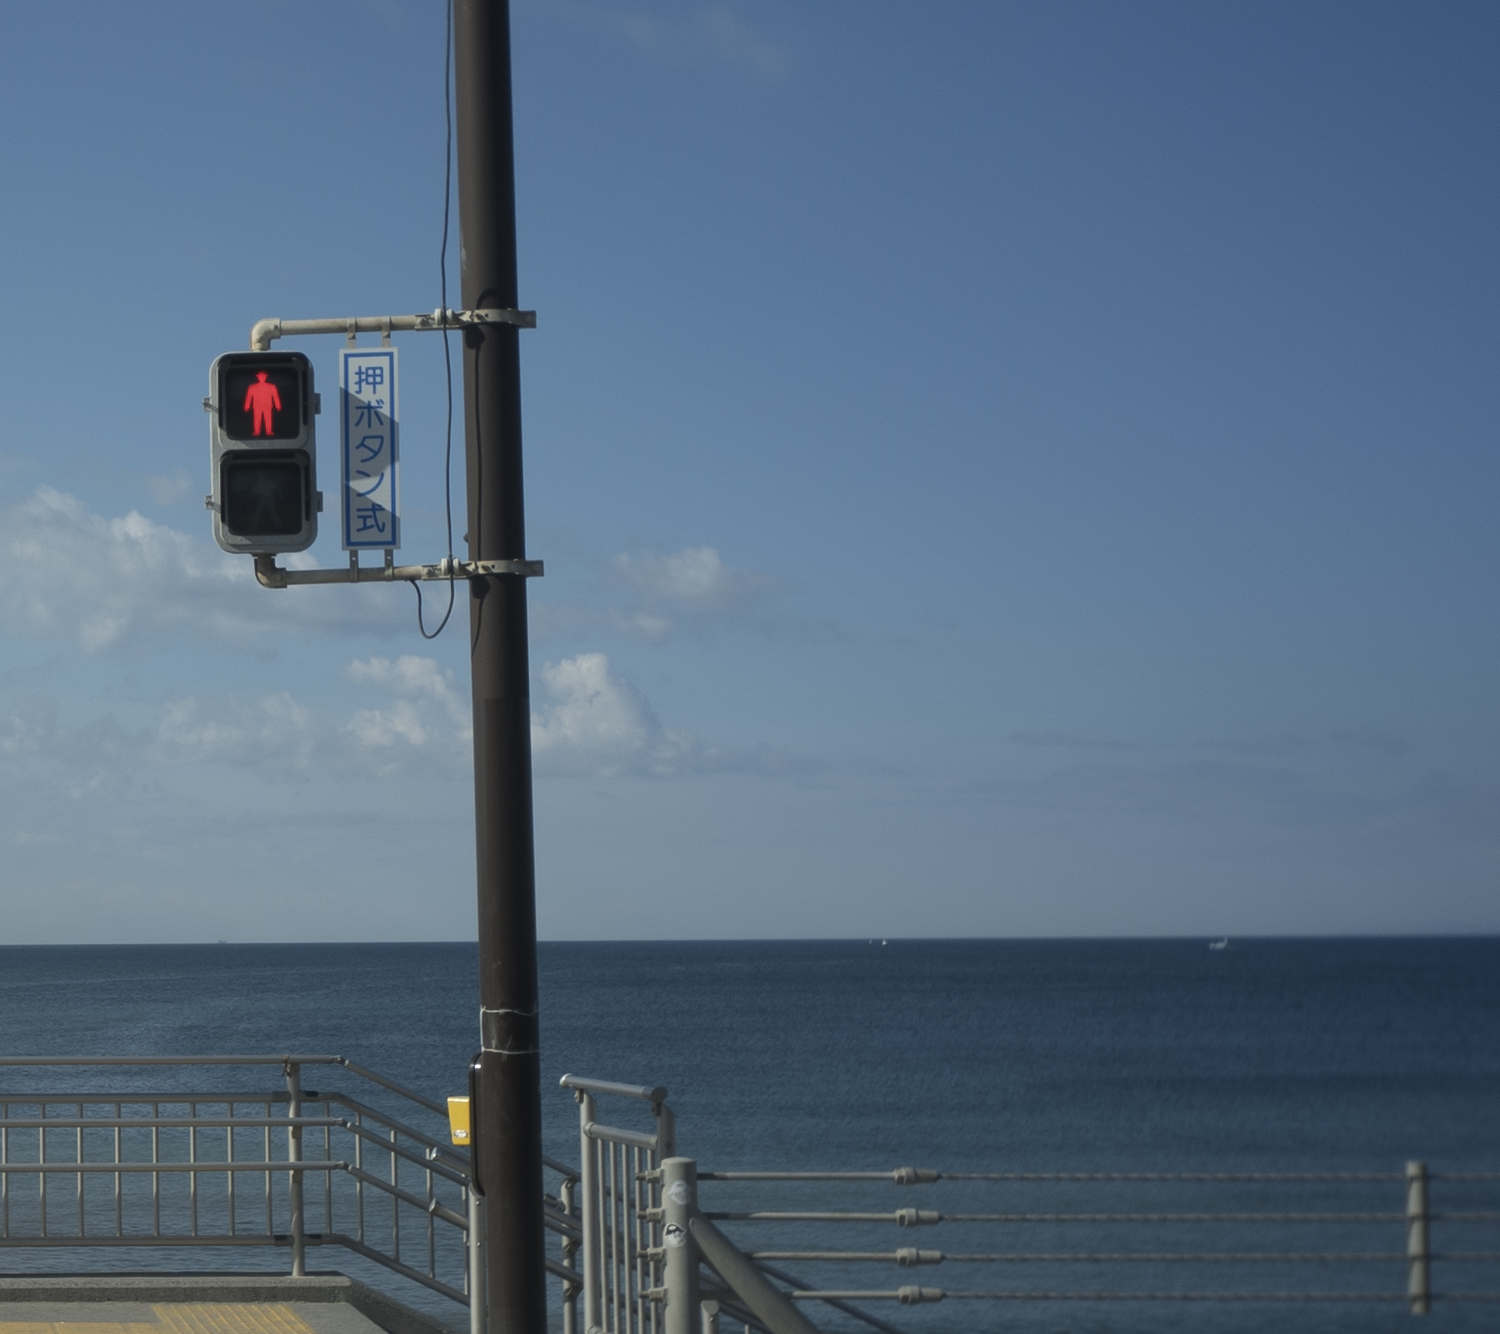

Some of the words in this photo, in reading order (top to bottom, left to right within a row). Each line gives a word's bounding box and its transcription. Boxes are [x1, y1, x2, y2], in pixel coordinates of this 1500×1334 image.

[354, 365, 386, 534] 押ボタン式
